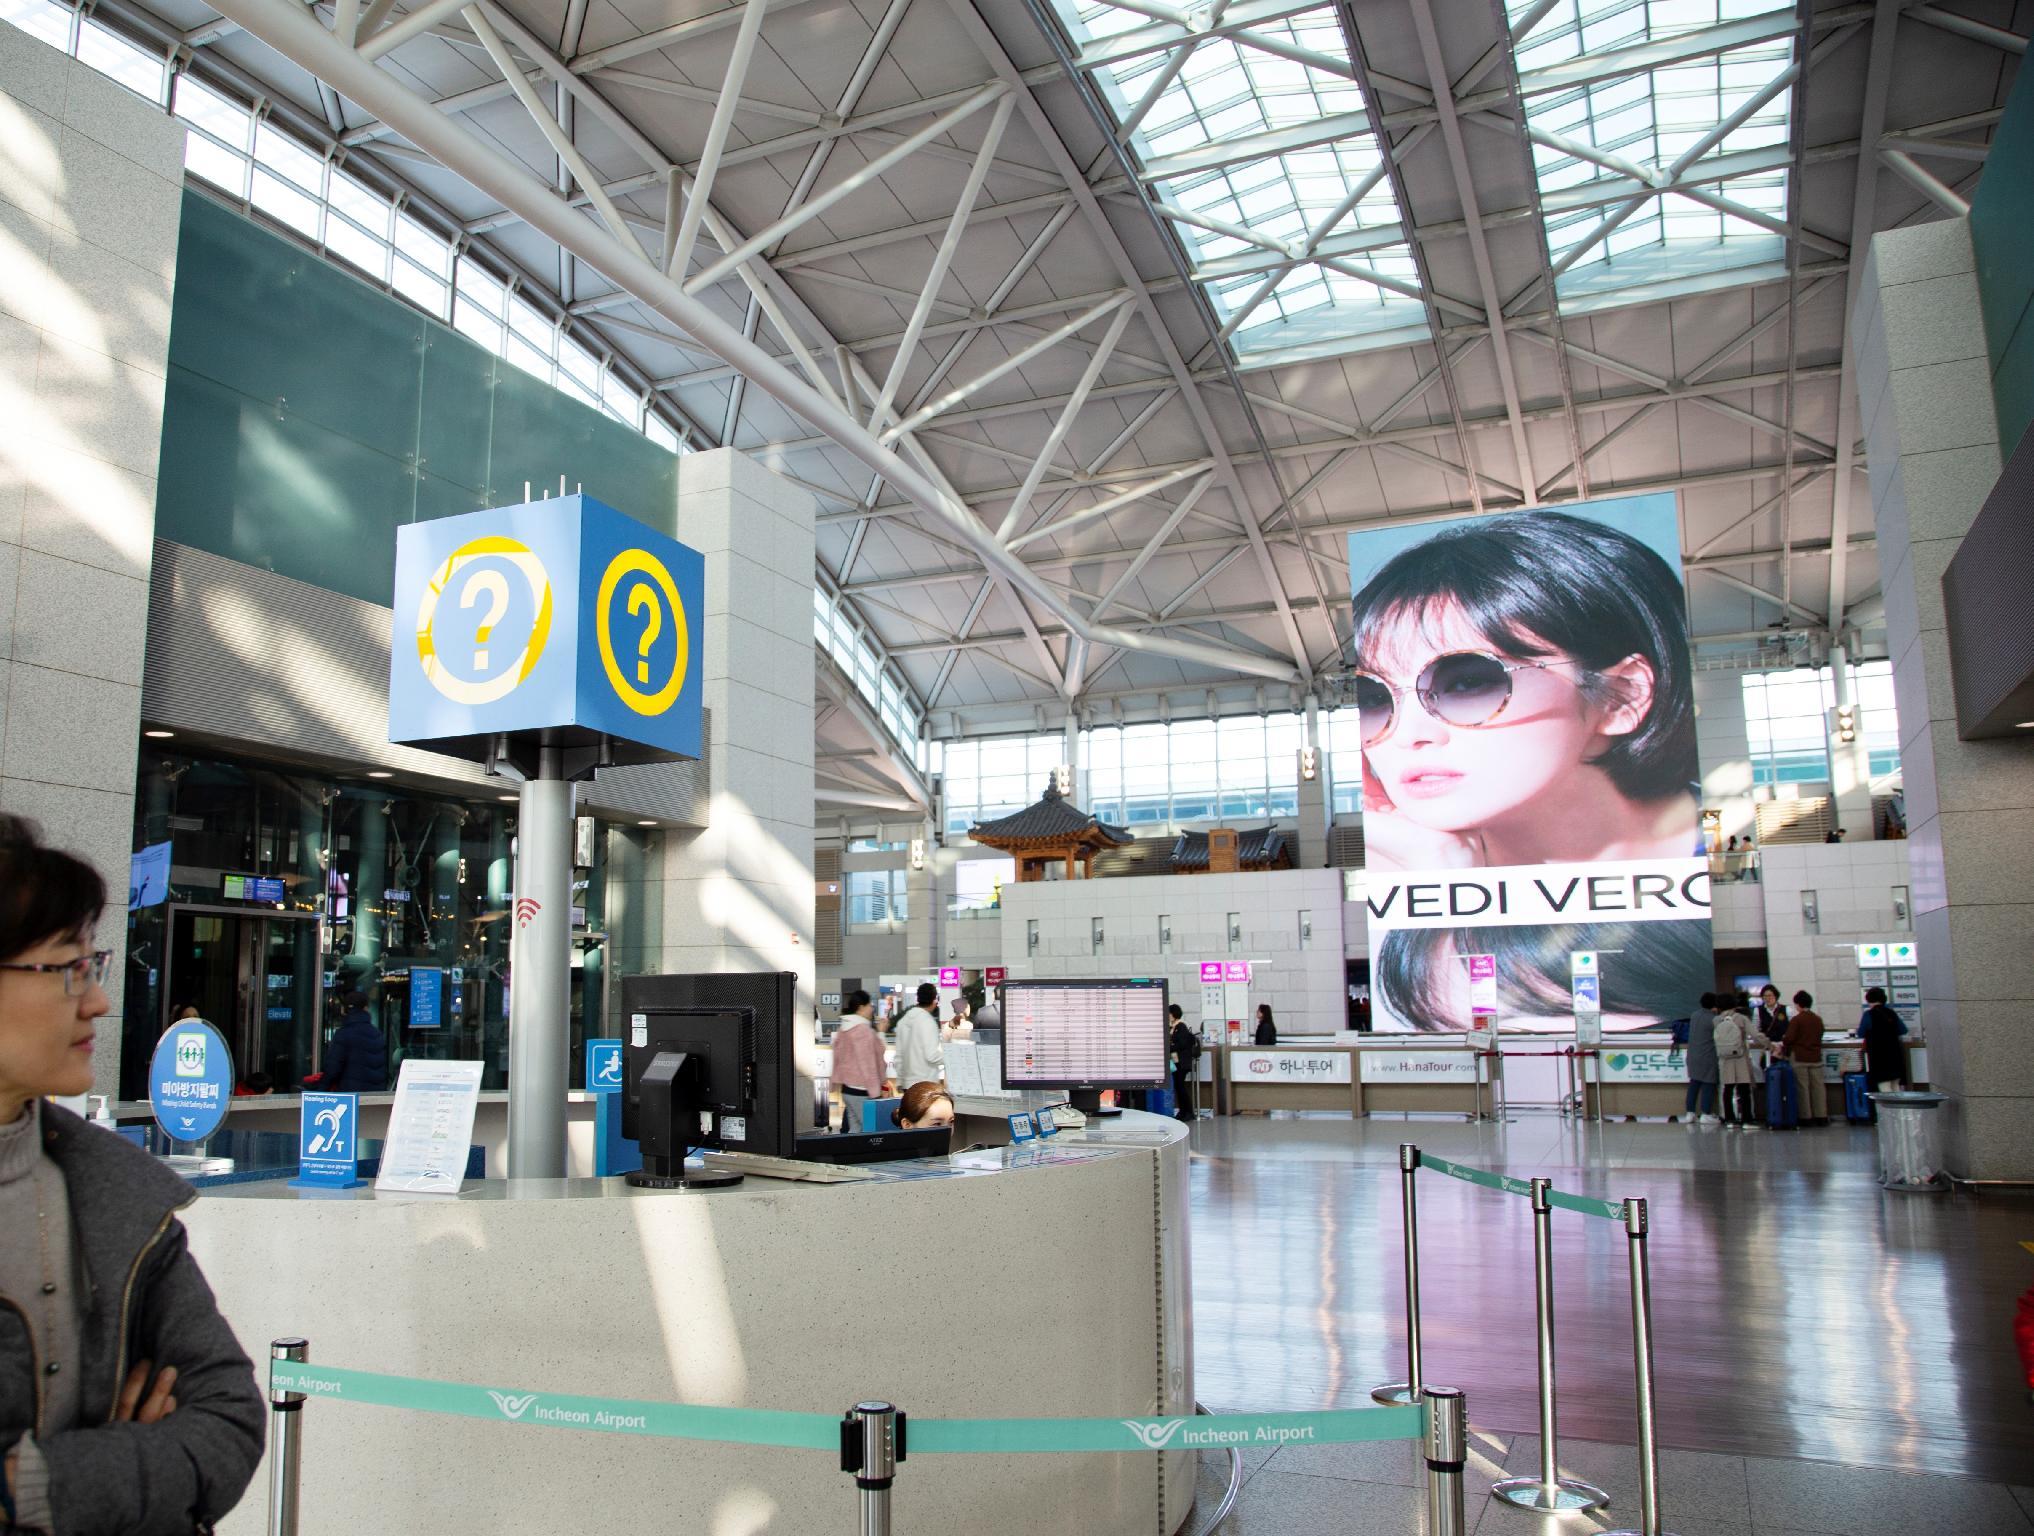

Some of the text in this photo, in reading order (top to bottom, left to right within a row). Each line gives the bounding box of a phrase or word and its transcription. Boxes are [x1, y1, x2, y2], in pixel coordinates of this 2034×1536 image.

[1368, 881, 1508, 918] VEDI
[1279, 1059, 1333, 1074] 하나투어
[161, 1081, 219, 1099] 미아방지팔찌
[298, 1375, 342, 1393] Airport
[535, 1404, 647, 1429] Incheon Airport
[1183, 1426, 1314, 1444] Incheon Airport
